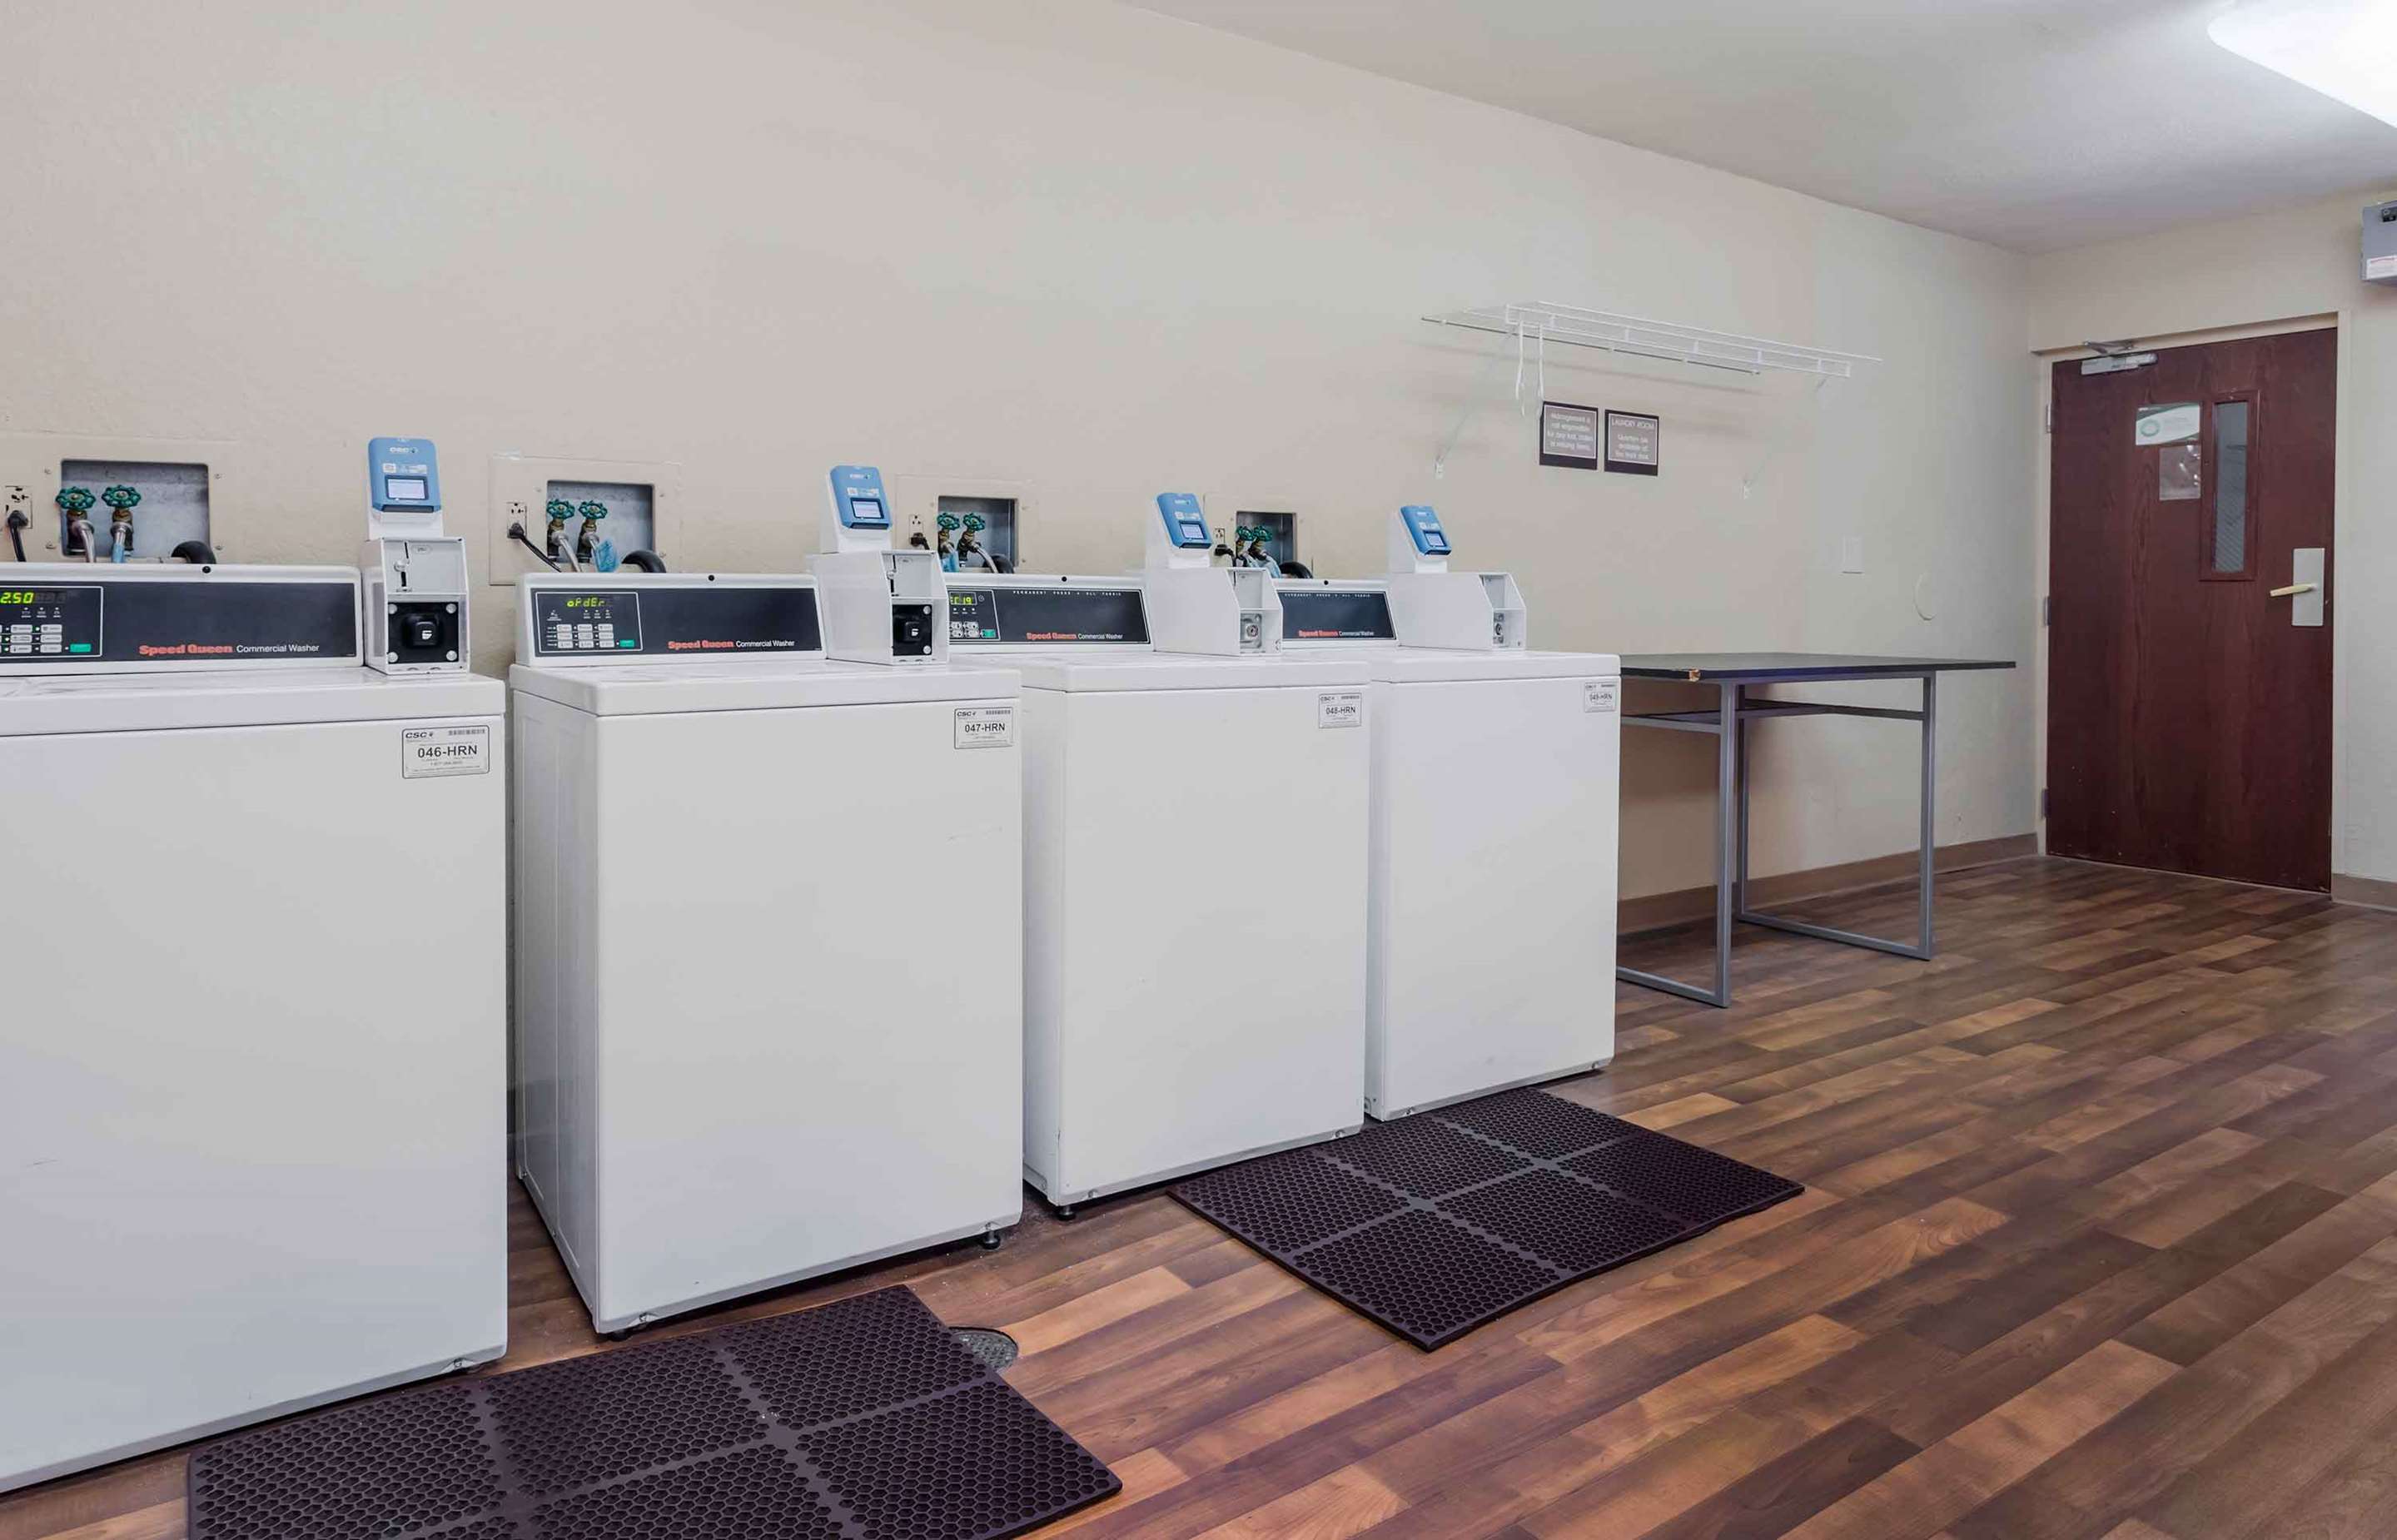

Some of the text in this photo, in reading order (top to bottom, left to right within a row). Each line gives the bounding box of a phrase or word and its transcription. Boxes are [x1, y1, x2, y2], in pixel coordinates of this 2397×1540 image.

[139, 643, 320, 657] Speed Queen Commercial Washer
[669, 641, 700, 650] Speed
[702, 640, 734, 648] Queen
[964, 723, 1005, 733] 047-HRN
[417, 745, 478, 758] 046-HRN
